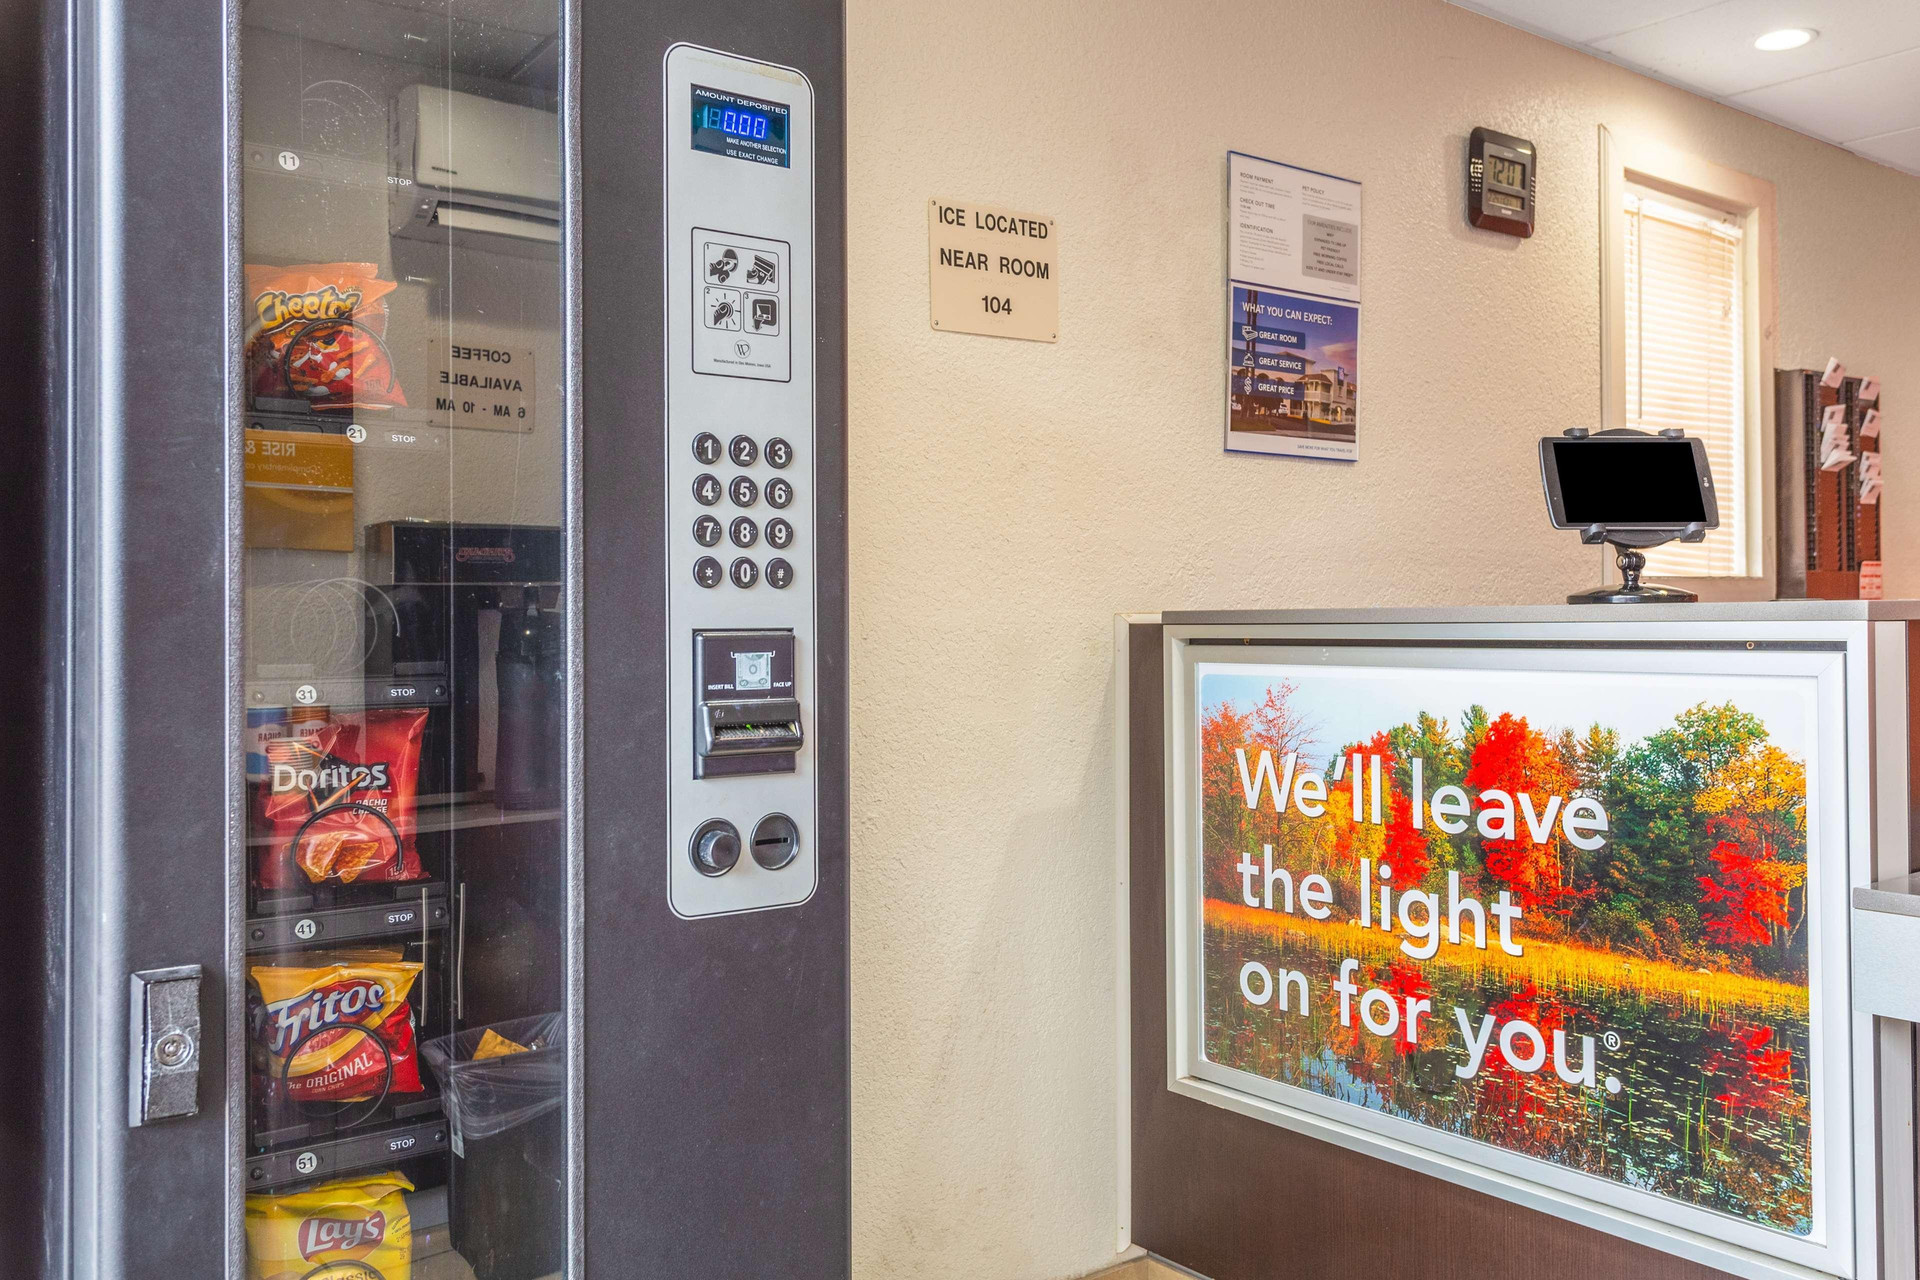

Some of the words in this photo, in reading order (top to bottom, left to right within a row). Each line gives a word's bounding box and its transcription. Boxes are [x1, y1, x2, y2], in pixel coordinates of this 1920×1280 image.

[696, 89, 735, 102] AMOUNT
[737, 98, 787, 114] DEPOSITED
[726, 137, 739, 145] MAKE
[740, 140, 761, 150] ANOTHER
[762, 144, 786, 154] SELECTION
[281, 154, 297, 167] 11
[738, 151, 756, 160] EXACT
[756, 155, 779, 165] CHANGE
[387, 176, 412, 187] STOP
[939, 205, 966, 227] ICE
[976, 211, 1048, 239] LOCATED
[940, 248, 988, 271] NEAR
[1000, 256, 1049, 280] ROOM
[256, 287, 361, 330] Cheetos
[981, 295, 1013, 315] 104
[1242, 302, 1265, 314] WHAT
[1267, 306, 1283, 318] YOU
[1285, 309, 1302, 320] CAN
[1304, 312, 1333, 326] EXPECT:
[1259, 331, 1278, 341] GREAT
[1279, 334, 1297, 343] ROOM
[1259, 357, 1278, 367] GREAT
[1279, 360, 1302, 370] SERVICE
[1258, 383, 1277, 393] GREAT
[1278, 385, 1294, 395] PRICE
[348, 428, 363, 440] 21
[392, 434, 416, 443] STOP
[704, 439, 713, 459] 1
[739, 441, 750, 460] 2
[775, 444, 786, 463] 3
[702, 480, 714, 500] 4
[739, 483, 750, 502] 5
[774, 484, 786, 503] 6
[703, 522, 714, 541] 7
[740, 523, 750, 543] 8
[775, 524, 786, 543] 9
[740, 563, 750, 583] 0
[298, 689, 314, 700] 31
[390, 688, 416, 697] STOP
[273, 763, 388, 792] Doritos
[1236, 748, 1383, 826] We'll
[1412, 758, 1609, 851] leave
[1237, 844, 1334, 920] the
[1360, 858, 1523, 960] light
[388, 912, 413, 923] STOP
[297, 923, 313, 935] 41
[1239, 961, 1309, 1017] on
[1333, 958, 1431, 1044] for
[265, 984, 385, 1052] Fritos
[306, 1052, 374, 1088] ORIGINAL
[390, 1138, 415, 1150] STOP
[298, 1157, 314, 1169] 51
[306, 1216, 381, 1254] Lay's
